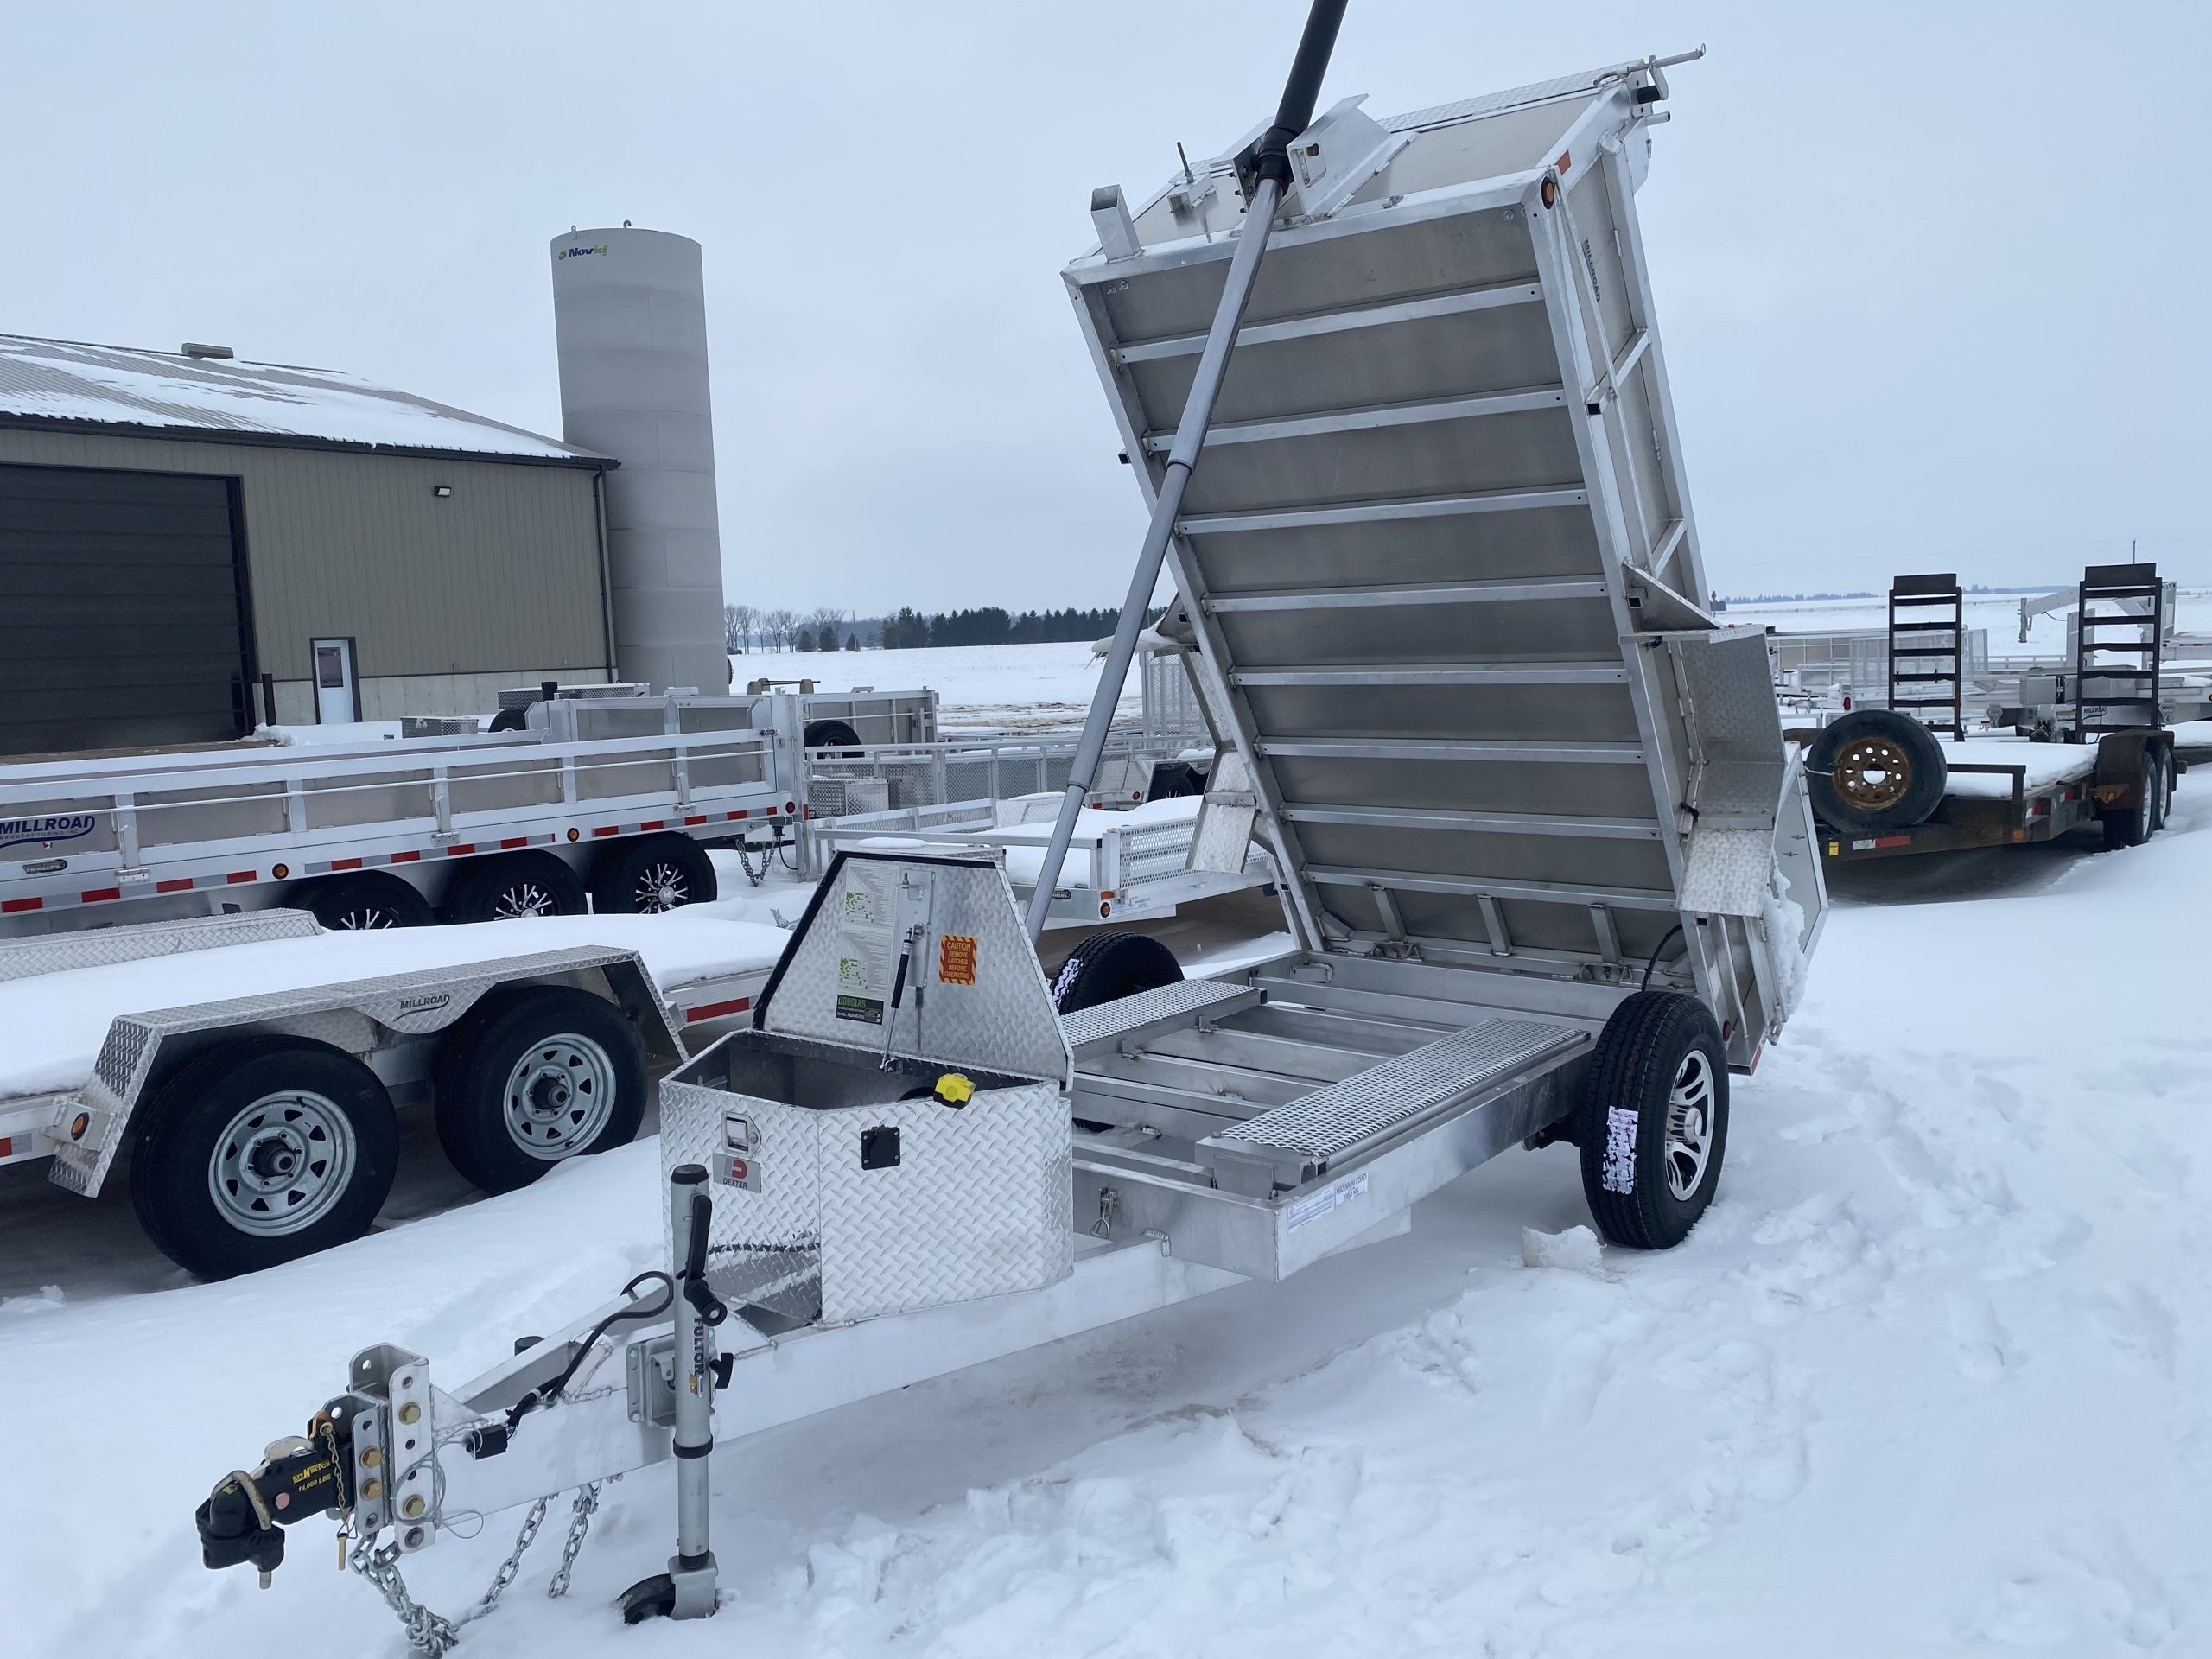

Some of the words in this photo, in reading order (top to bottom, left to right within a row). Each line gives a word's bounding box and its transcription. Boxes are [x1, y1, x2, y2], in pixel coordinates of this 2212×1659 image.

[1583, 239, 1600, 302] MILLROAD
[0, 816, 95, 835] MILLROAD
[947, 942, 970, 950] CAUTION
[944, 970, 970, 979] OPERATING
[400, 995, 449, 1009] MILLROAD
[838, 996, 866, 1008] DOUGLAS
[723, 1177, 747, 1189] DEXTER
[693, 1319, 704, 1375] FULTON
[319, 1473, 332, 1484] LBS
